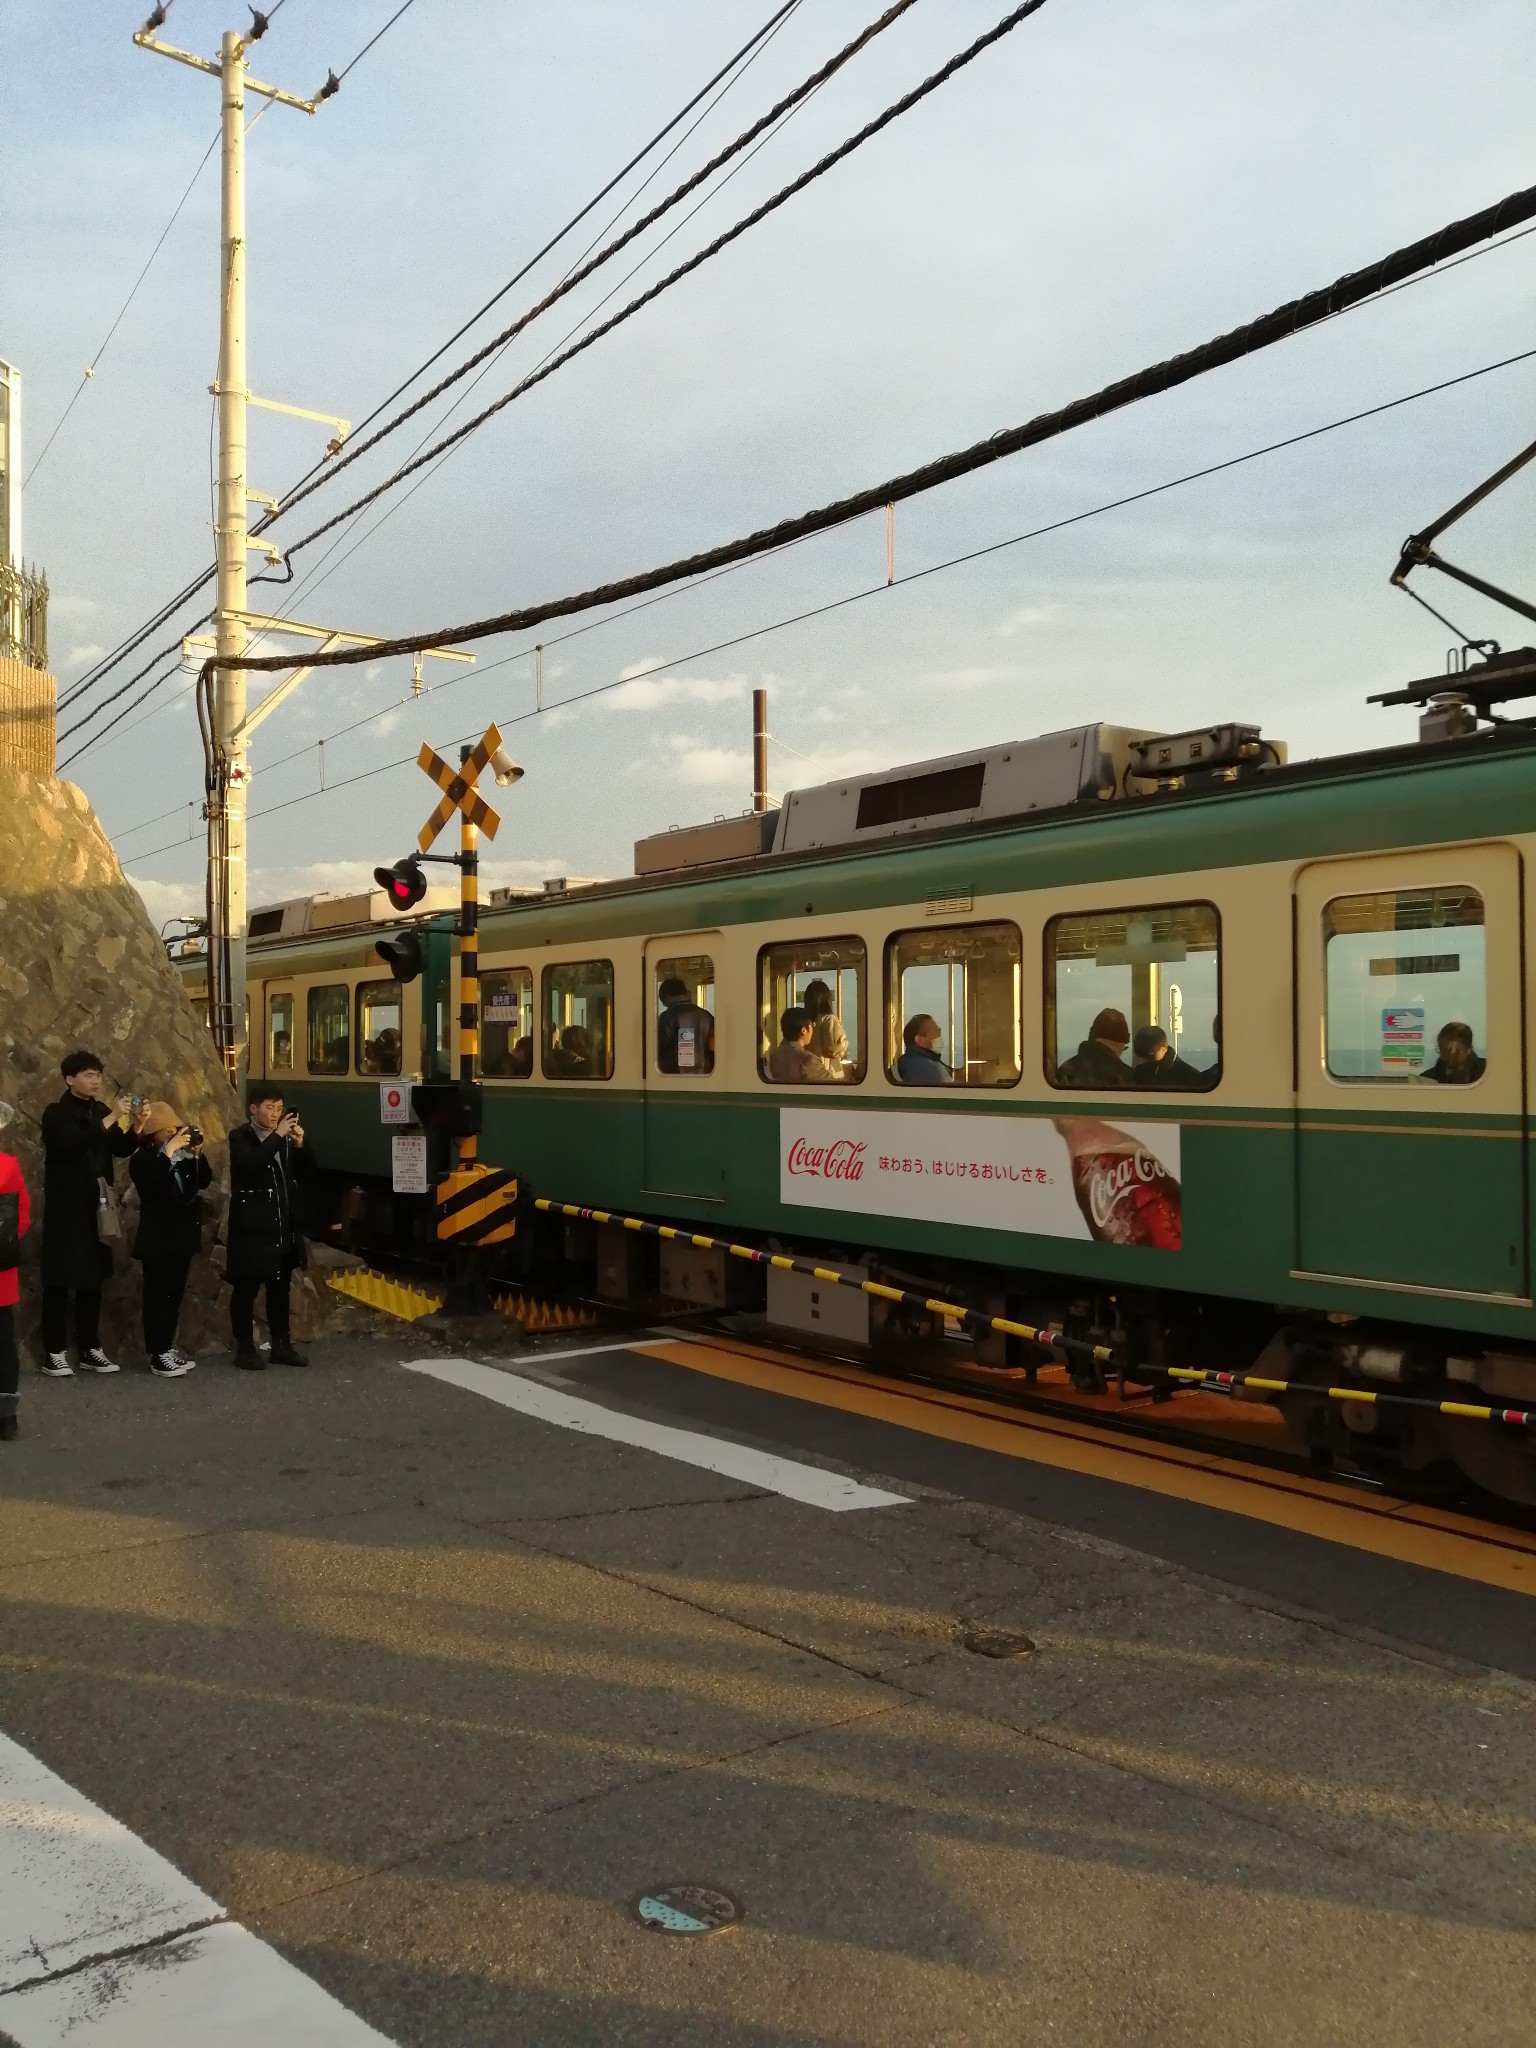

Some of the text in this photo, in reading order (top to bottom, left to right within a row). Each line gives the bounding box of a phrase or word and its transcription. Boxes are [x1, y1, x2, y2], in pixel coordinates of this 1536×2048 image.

[787, 1136, 869, 1182] Coca-Cola
[878, 1156, 1055, 1185] 味わおう、はじけるおいしさを。
[1090, 1148, 1175, 1228] Coca-Co
